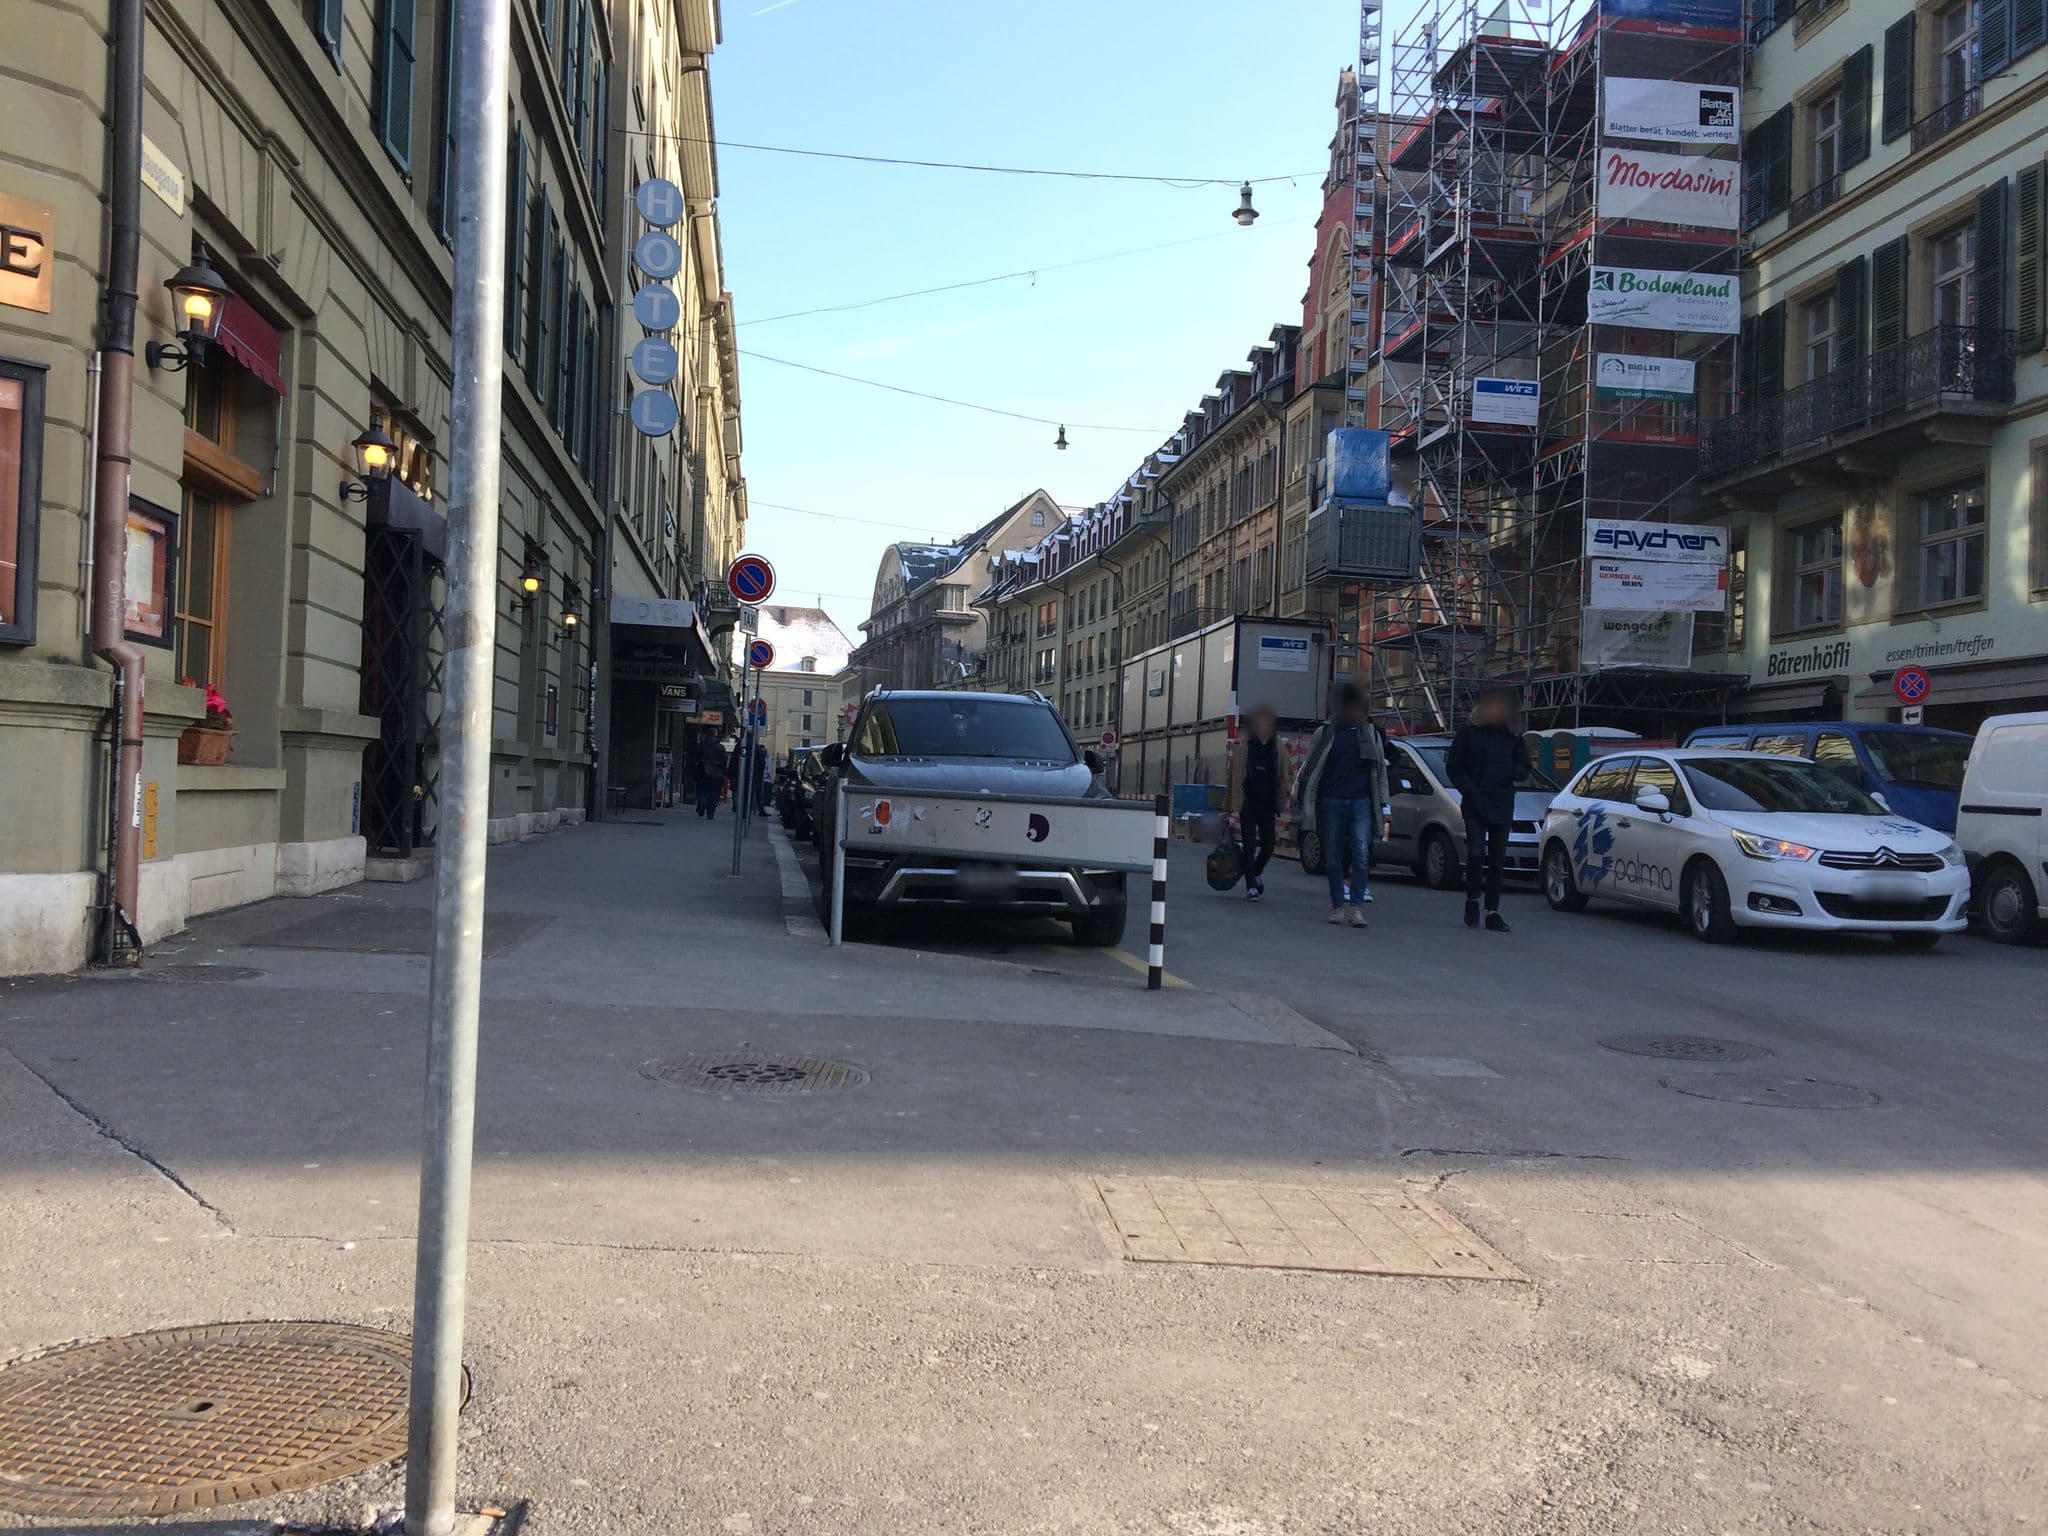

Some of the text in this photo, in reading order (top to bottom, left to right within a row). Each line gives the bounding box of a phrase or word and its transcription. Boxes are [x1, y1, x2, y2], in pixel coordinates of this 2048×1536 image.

[1701, 98, 1732, 109] Blatter
[1715, 110, 1732, 118] AG
[1609, 122, 1638, 132] Blatter
[1708, 116, 1732, 126] Bern
[1606, 153, 1734, 197] Mordasini
[1617, 272, 1731, 298] Bodenland
[641, 184, 676, 430] HOTEL
[1627, 363, 1661, 372] BIGLER
[1504, 382, 1534, 394] wirz
[1598, 520, 1621, 528] Ruedi
[1593, 528, 1721, 551] spycher
[1710, 554, 1721, 562] AG
[743, 611, 757, 628] TAXI
[1603, 621, 1653, 634] wenger
[1886, 634, 1995, 663] essen/trinken/treffen
[1767, 641, 1852, 677] Bärenhöfli
[660, 684, 687, 697] VANS
[1613, 851, 1673, 892] palma
